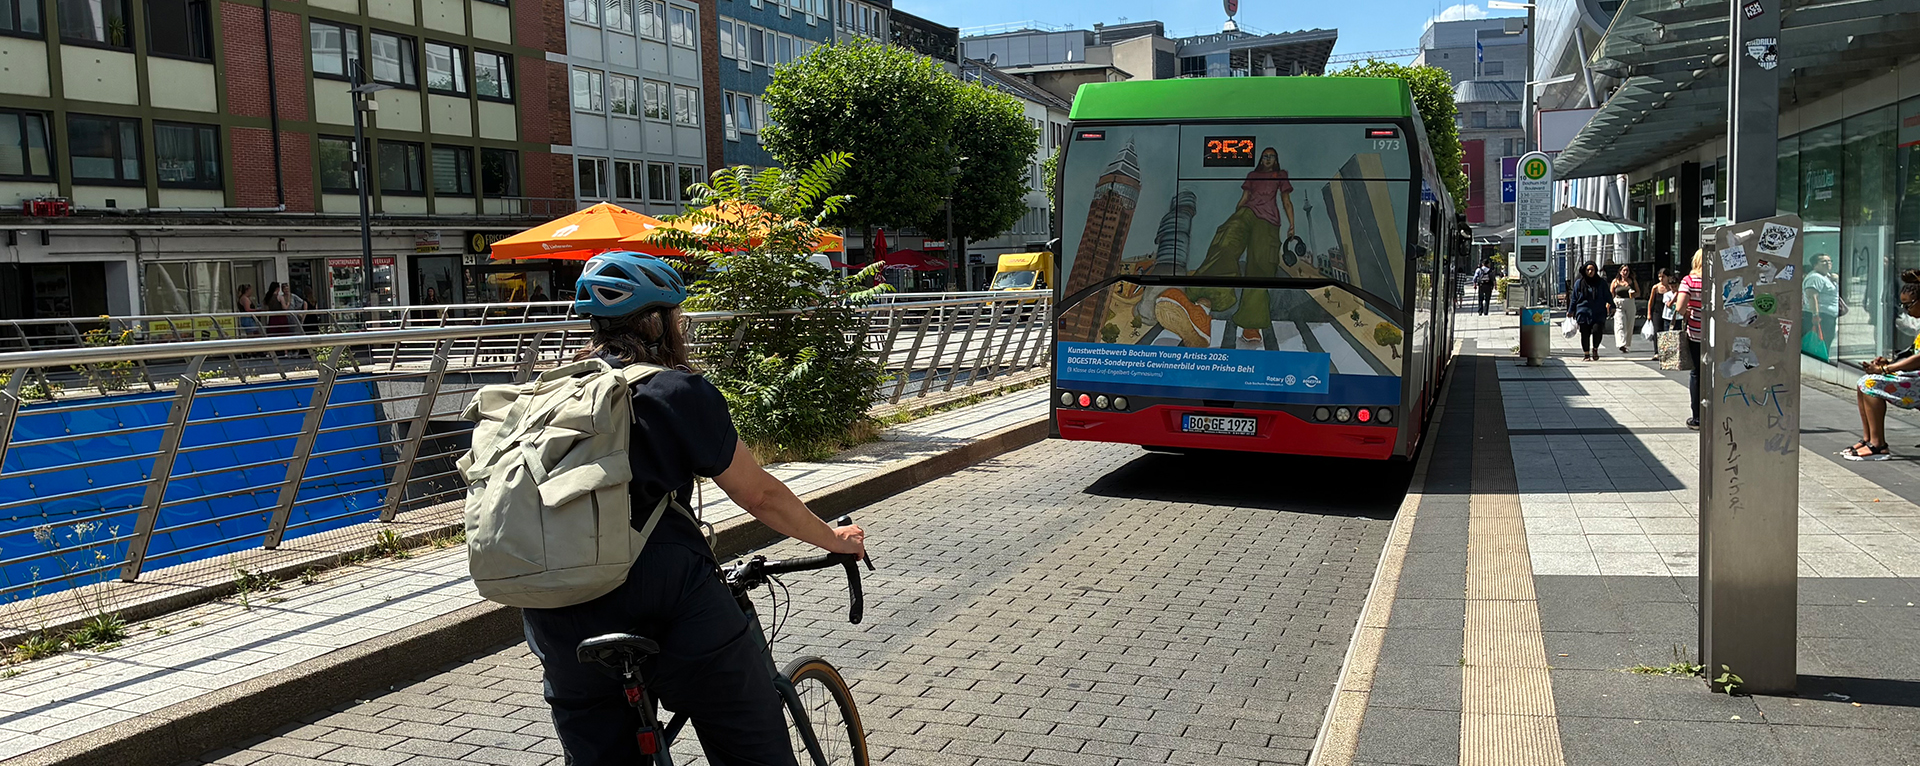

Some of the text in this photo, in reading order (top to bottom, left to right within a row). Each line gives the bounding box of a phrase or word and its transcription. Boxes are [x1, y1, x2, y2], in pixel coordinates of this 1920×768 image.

[1373, 140, 1400, 150] 1973
[464, 255, 474, 264] 24
[1067, 346, 1229, 361] Kunstwettbewerb Bochum Young Artists 2026:
[1067, 357, 1145, 368] BOGESTRA-Sonderpreis
[1146, 360, 1195, 370] Gewinnerbild
[1211, 364, 1236, 372] Prisha
[1237, 365, 1255, 373] Behl
[1266, 375, 1284, 383] Rotary
[1190, 417, 1255, 432] BO GE 1973
